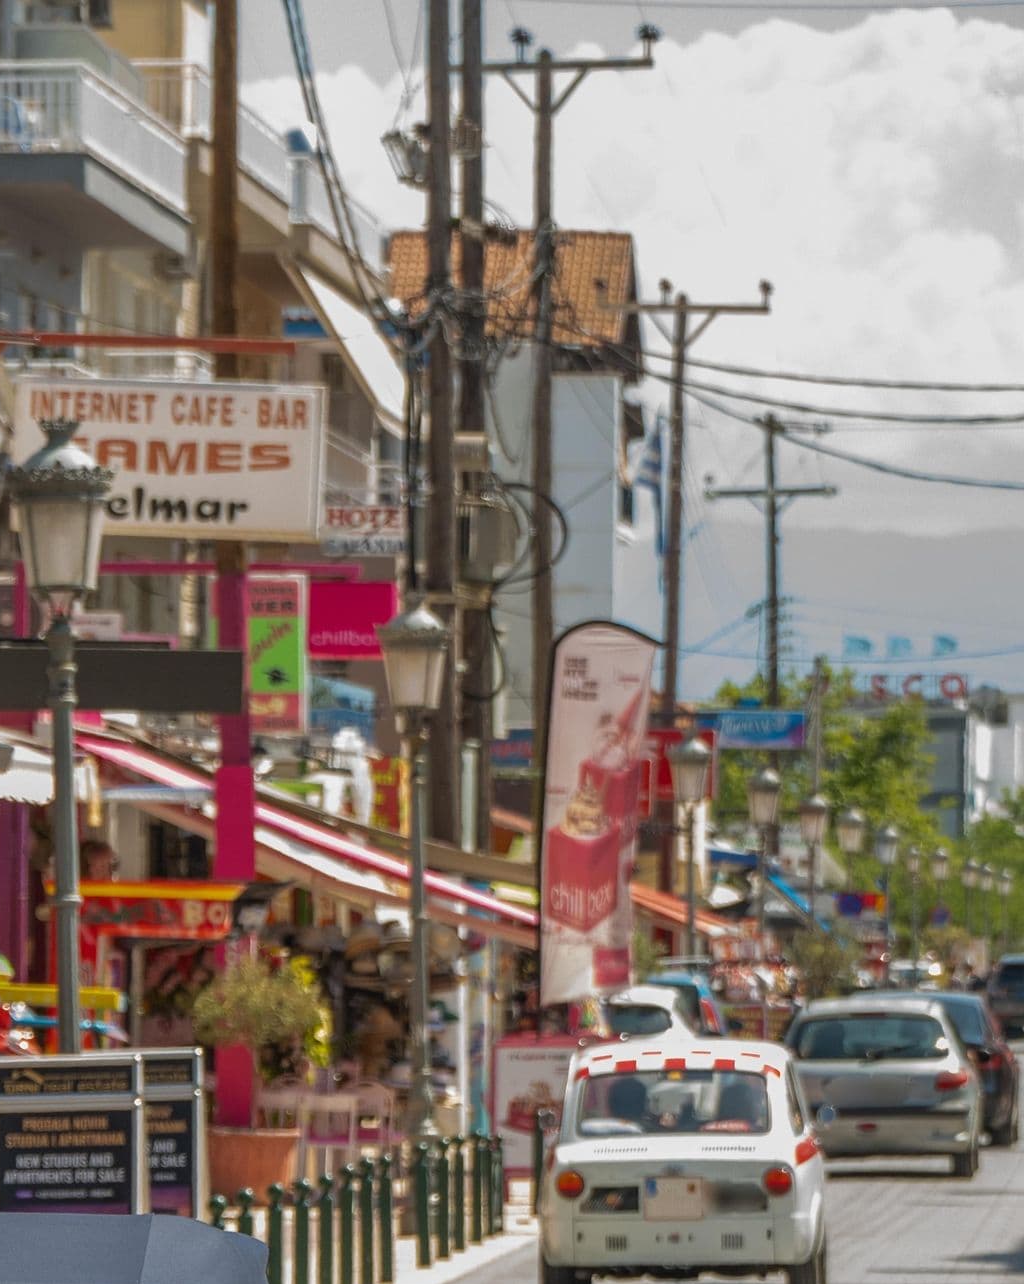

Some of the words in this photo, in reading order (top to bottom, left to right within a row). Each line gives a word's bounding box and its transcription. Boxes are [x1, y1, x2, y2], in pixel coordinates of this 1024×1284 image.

[30, 391, 159, 424] INTERNET
[170, 395, 233, 428] CAFE
[257, 398, 308, 430] BAR
[72, 437, 292, 476] AMES
[311, 629, 378, 647] chillbo
[15, 1154, 41, 1169] NEW
[42, 1153, 88, 1169] STUDIOS
[89, 1152, 115, 1168] AND
[160, 1153, 188, 1168] SALE
[3, 1169, 73, 1185] APARTMENTS
[75, 1169, 97, 1184] FOR
[97, 1167, 126, 1183] SALE
